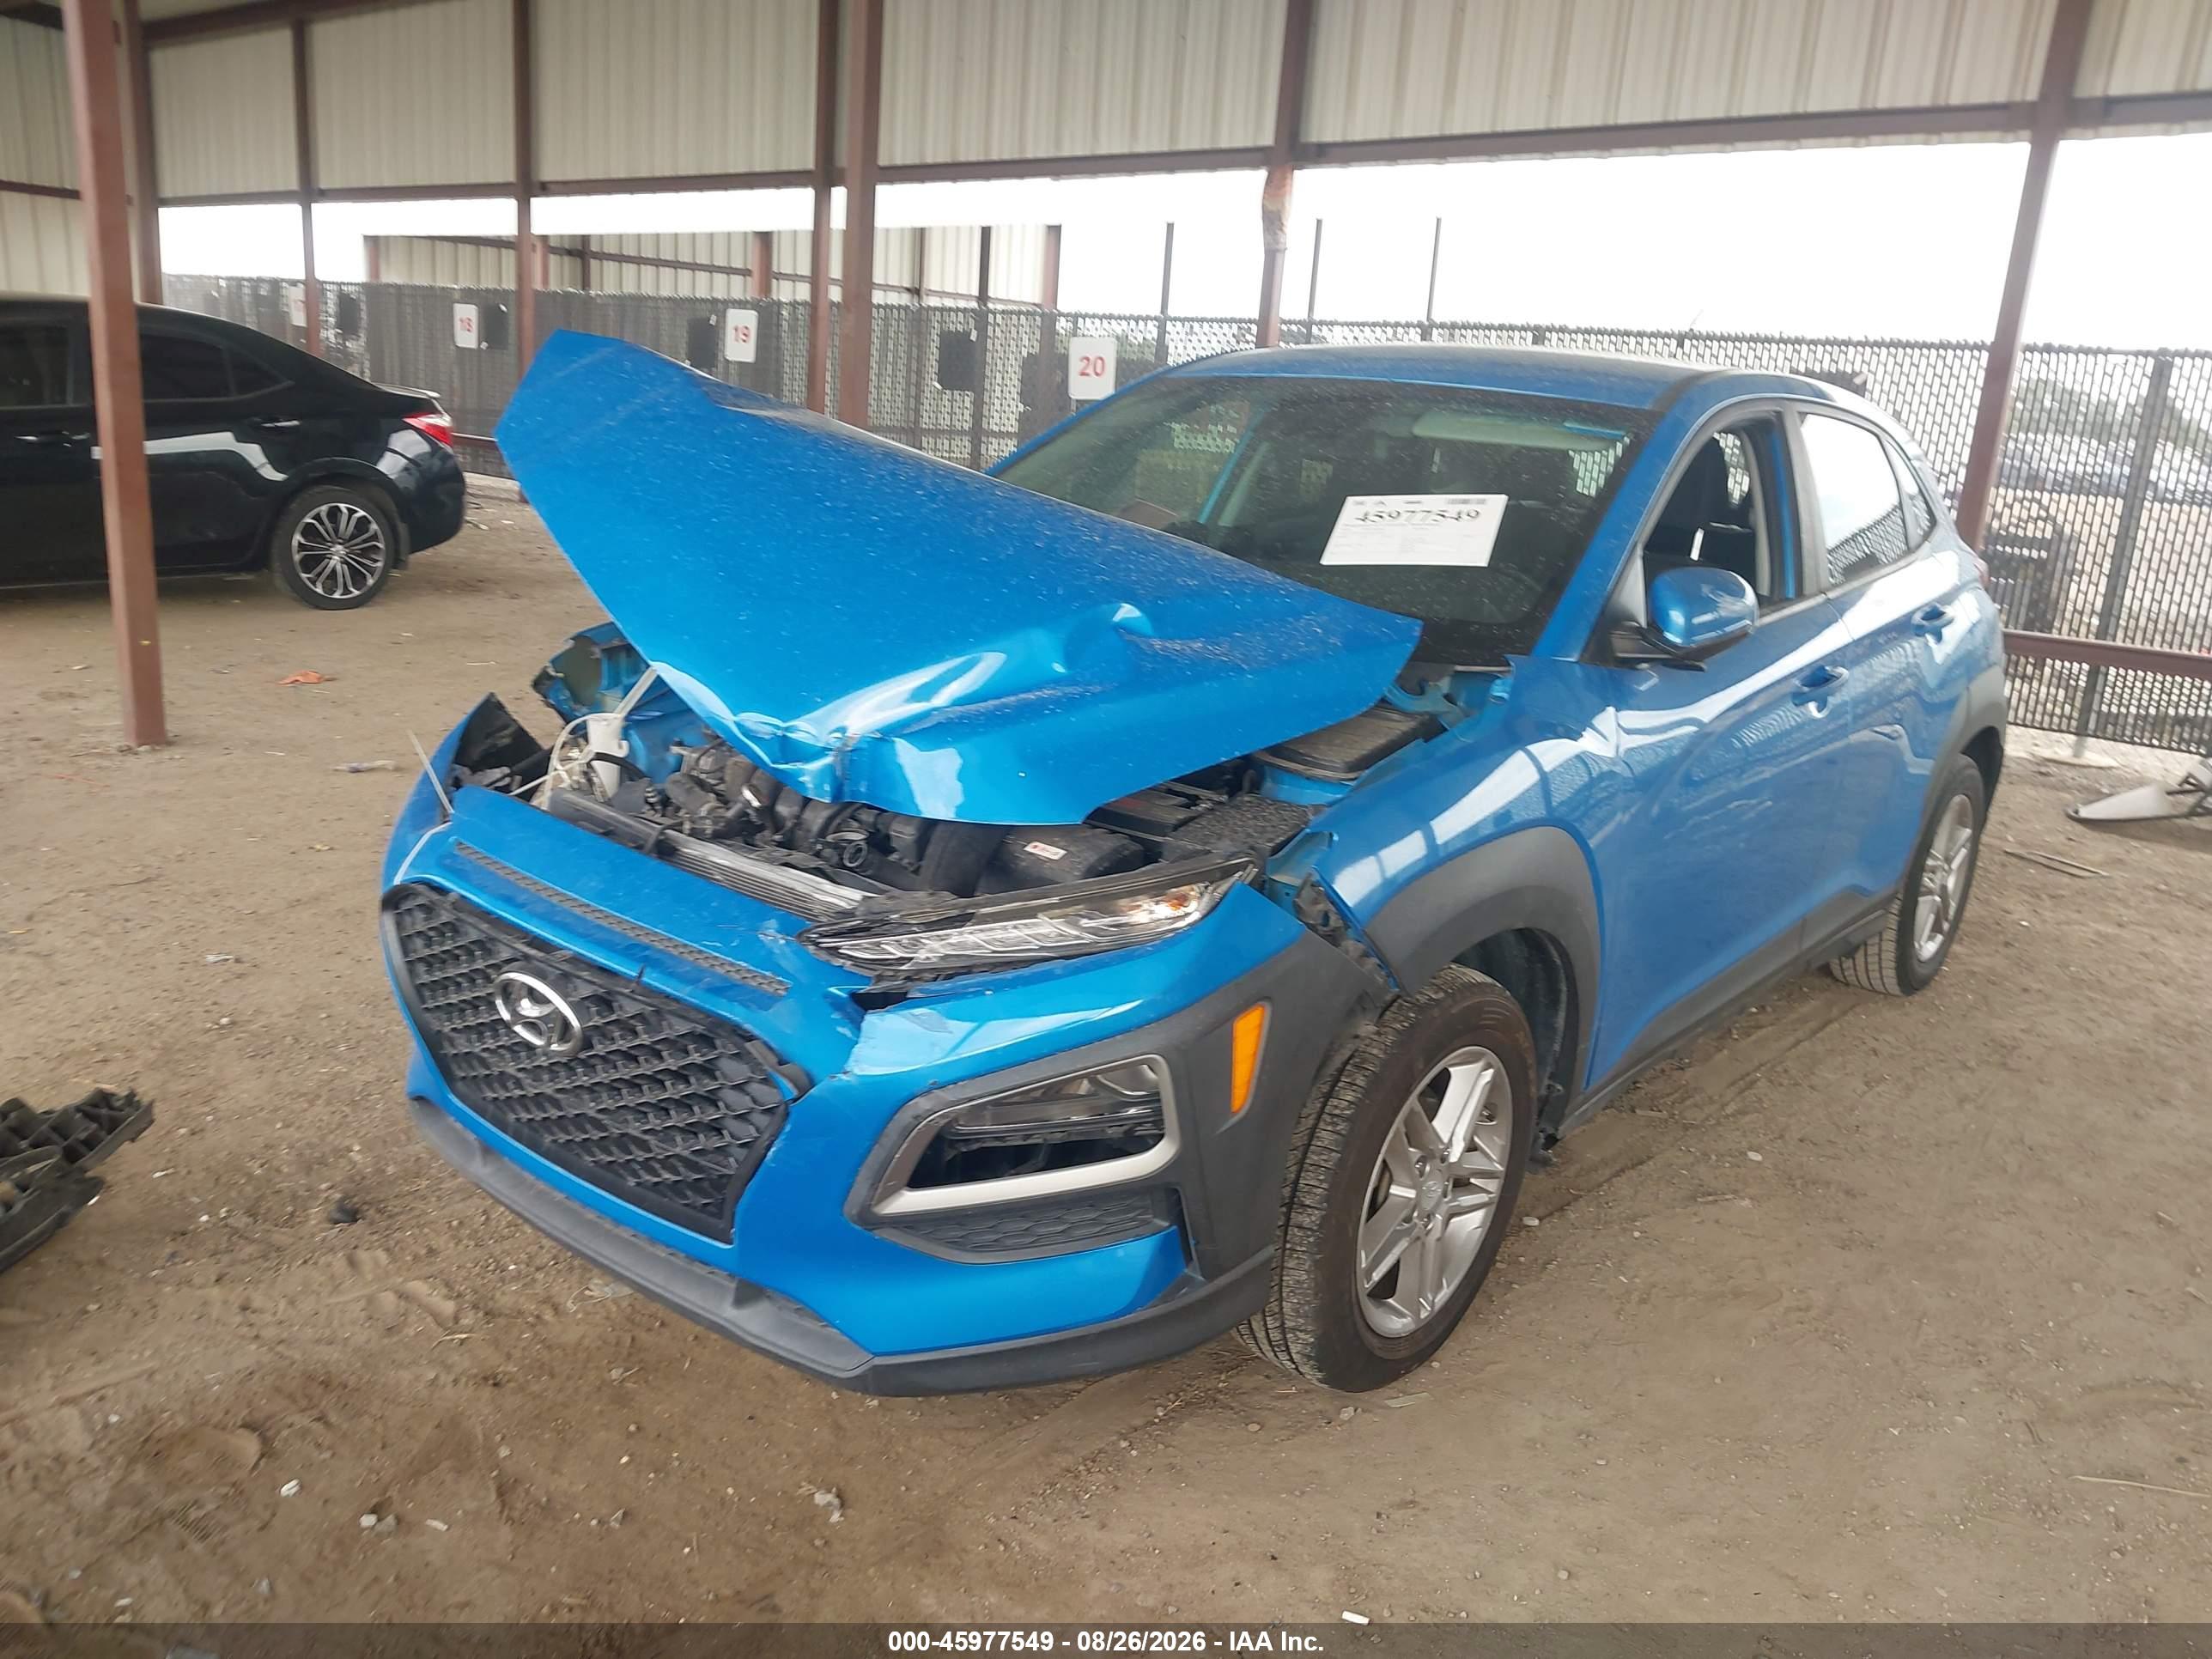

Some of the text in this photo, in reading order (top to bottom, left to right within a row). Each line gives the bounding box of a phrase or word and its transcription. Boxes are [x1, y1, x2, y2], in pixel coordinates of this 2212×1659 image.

[733, 325, 751, 343] 19
[1079, 356, 1106, 377] 20
[1353, 507, 1480, 523] 45977549
